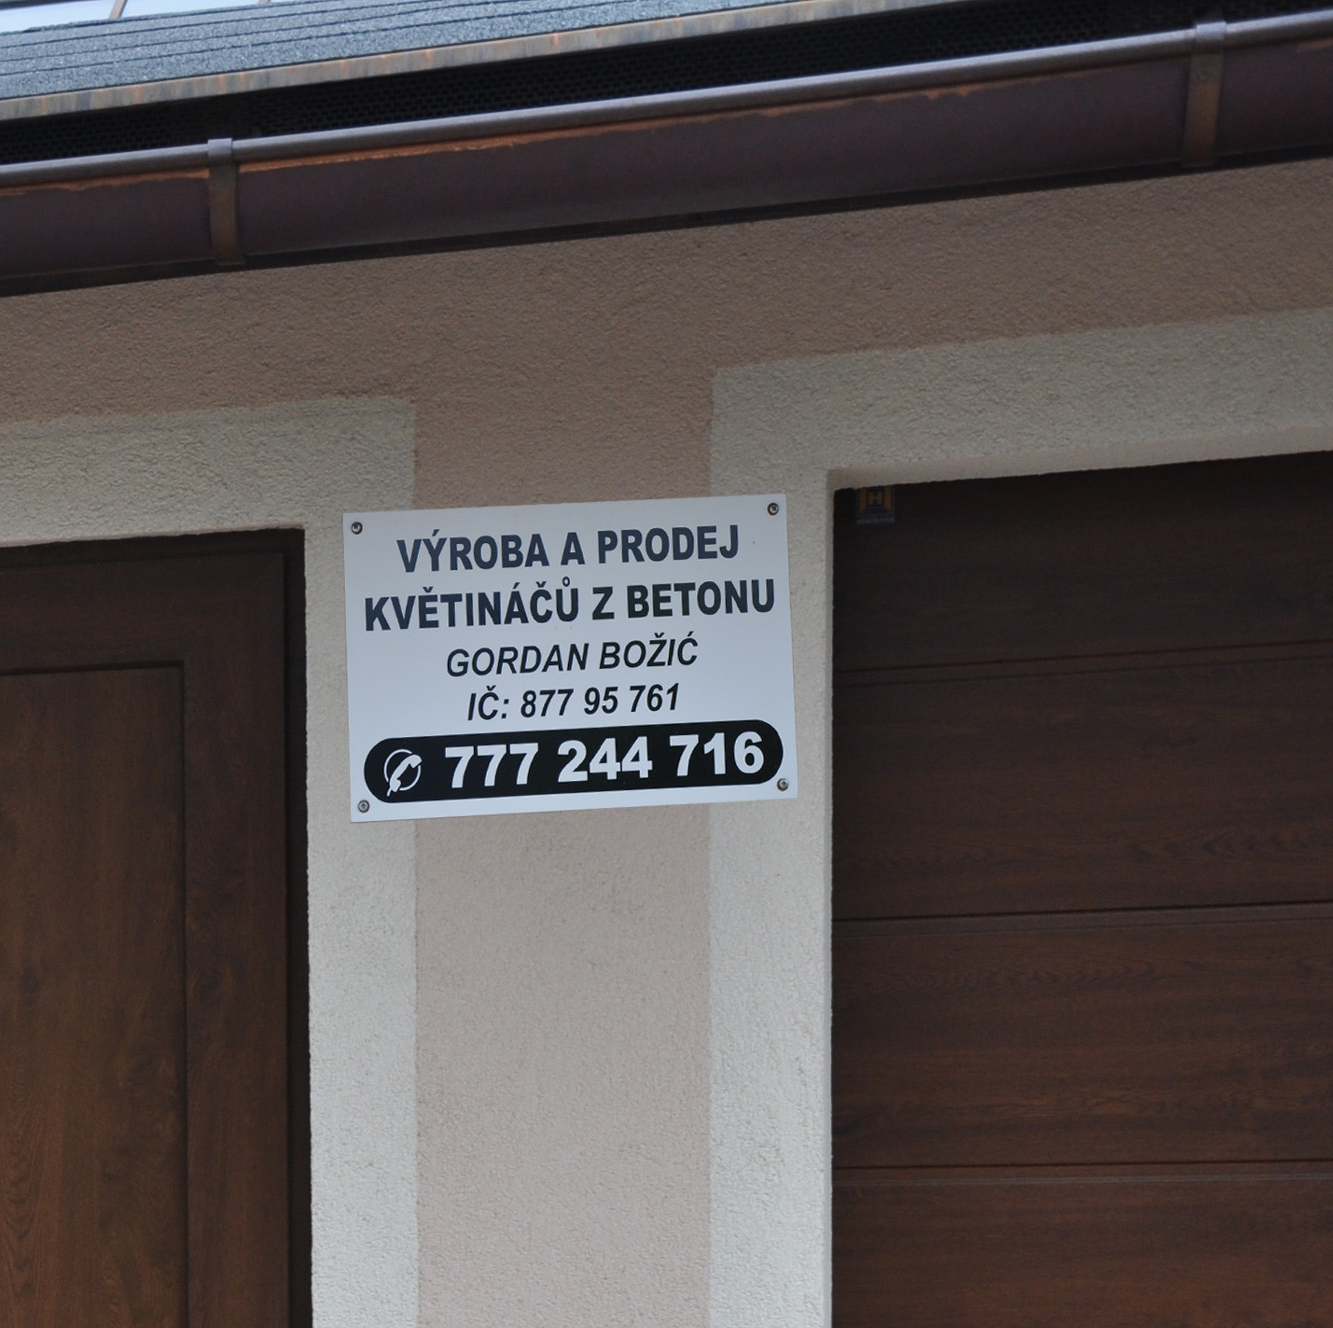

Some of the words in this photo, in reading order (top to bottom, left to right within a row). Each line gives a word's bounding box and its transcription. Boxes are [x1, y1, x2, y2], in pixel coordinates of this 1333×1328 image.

[397, 529, 549, 572] VÝROBA
[561, 532, 585, 565] A
[598, 525, 738, 564] PRODEJ
[365, 577, 578, 631] KVĚTINÁČŮ
[592, 586, 614, 620] Z
[627, 579, 774, 618] BETONU
[447, 643, 589, 677] GORDAN
[599, 631, 698, 669] BOŽIĆ
[468, 685, 509, 720] IČ:
[521, 689, 574, 718] 877
[584, 687, 618, 714] 95
[630, 683, 678, 712] 761
[445, 743, 538, 788] 777
[558, 737, 652, 782] 244
[670, 732, 764, 776] 716
